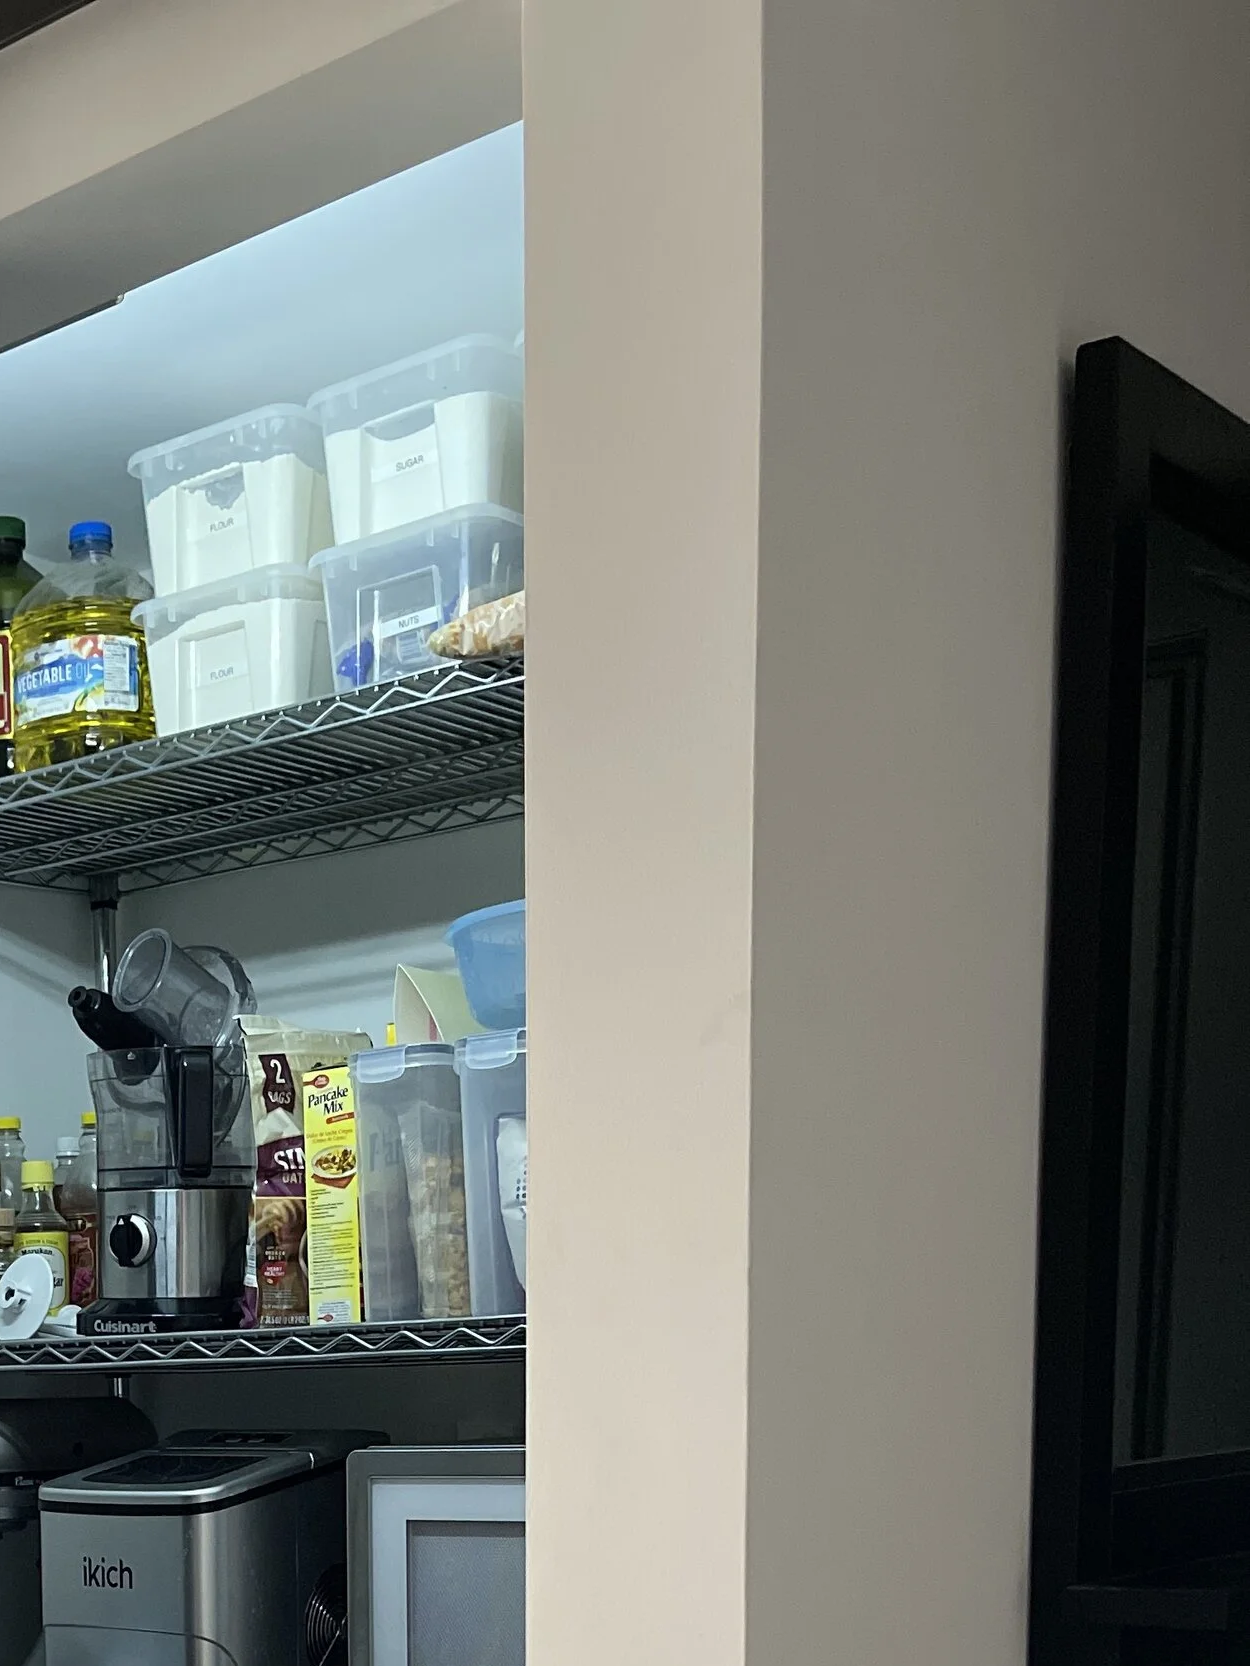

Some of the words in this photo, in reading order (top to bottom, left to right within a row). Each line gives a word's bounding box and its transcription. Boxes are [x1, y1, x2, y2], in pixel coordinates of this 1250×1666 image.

[395, 454, 425, 473] SUGAR
[209, 517, 235, 533] FLOUR
[398, 614, 420, 629] NUTS
[16, 663, 72, 694] VEGETABLE
[209, 666, 235, 681] FLOUR
[270, 1058, 286, 1084] 2
[308, 1086, 349, 1109] Pancake
[323, 1100, 344, 1116] Mix
[93, 1319, 156, 1333] Cuisinart
[82, 1556, 134, 1589] ikich
